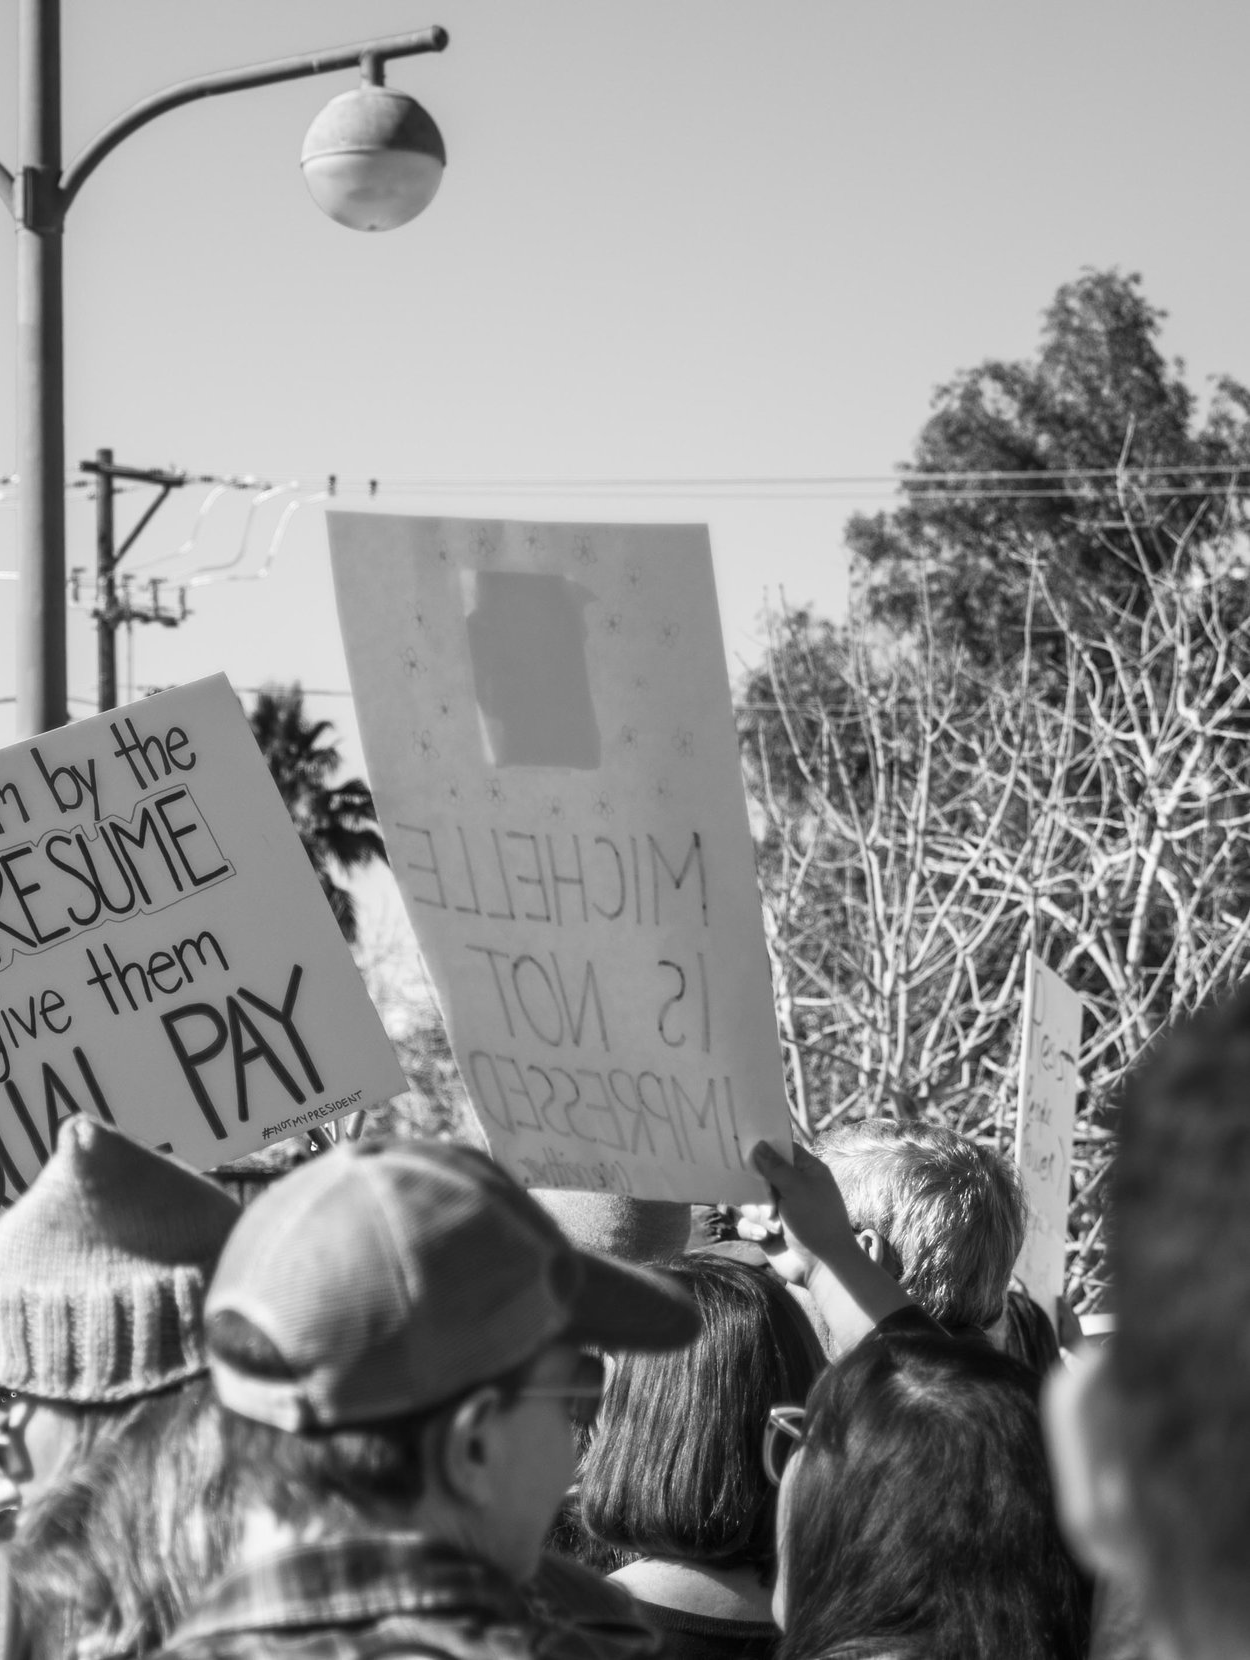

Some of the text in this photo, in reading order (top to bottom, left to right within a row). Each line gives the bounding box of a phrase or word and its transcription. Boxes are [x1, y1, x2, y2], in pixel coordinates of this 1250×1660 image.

[30, 747, 100, 821] by
[110, 717, 196, 790] the
[86, 931, 229, 1015] them
[160, 964, 325, 1140] PAY
[261, 1090, 364, 1141] #NOTMYPRESIDENT
